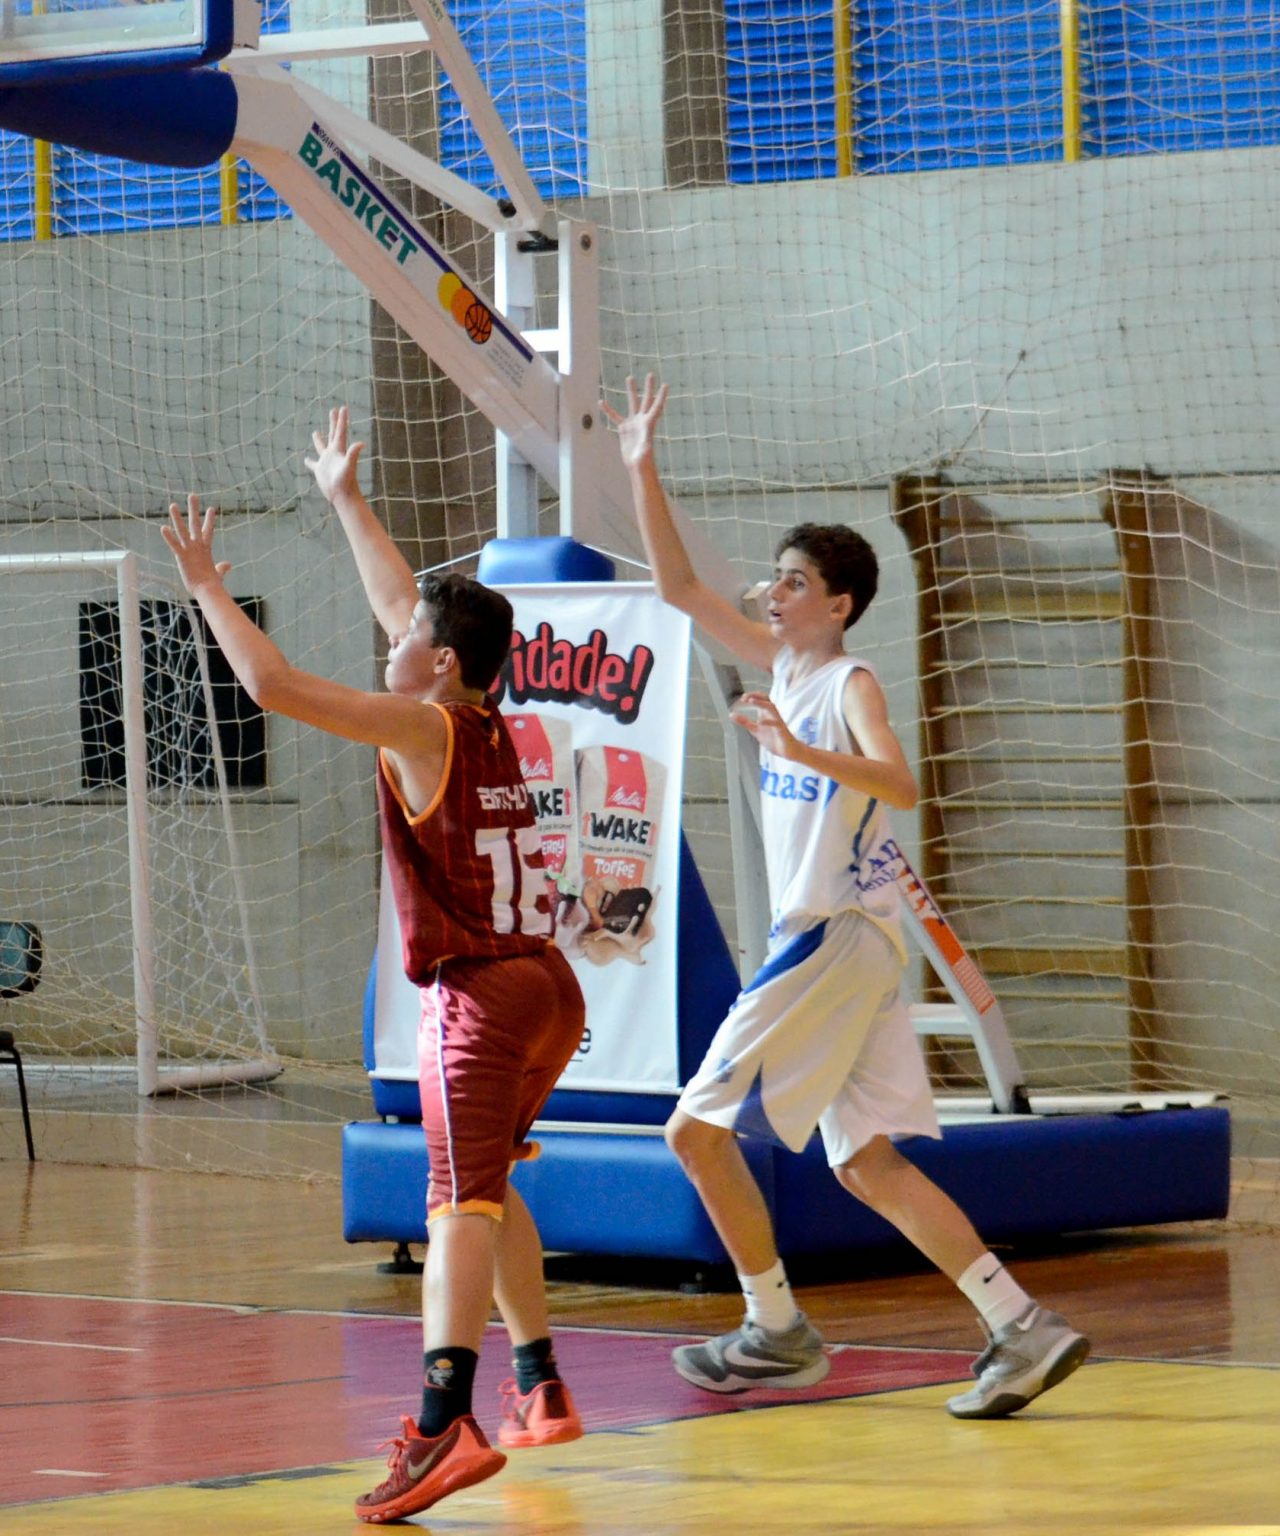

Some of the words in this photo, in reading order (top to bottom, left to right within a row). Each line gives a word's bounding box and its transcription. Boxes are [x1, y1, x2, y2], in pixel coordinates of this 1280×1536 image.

[298, 132, 418, 265] BASKET
[489, 621, 654, 722] idade!
[590, 811, 651, 846] WAKE
